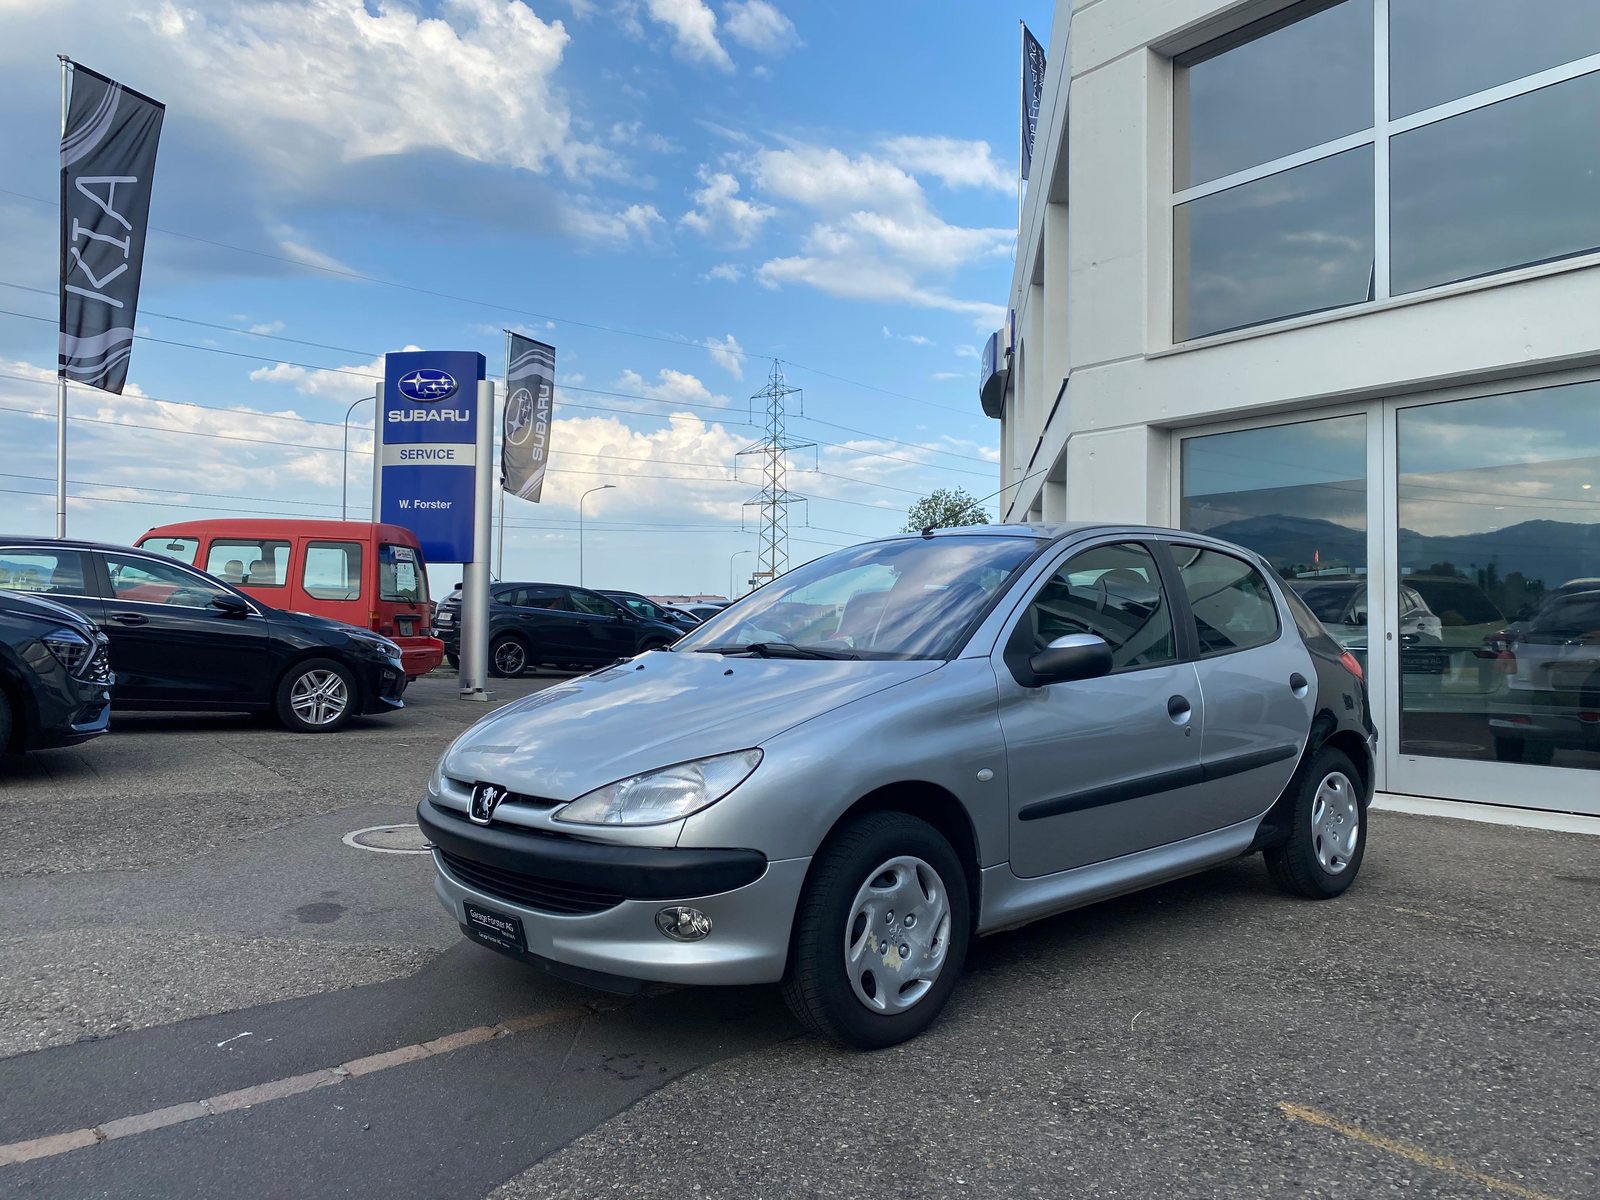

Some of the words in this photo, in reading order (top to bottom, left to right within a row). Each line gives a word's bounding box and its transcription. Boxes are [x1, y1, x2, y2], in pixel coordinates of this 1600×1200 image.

[65, 176, 137, 308] KIA
[388, 409, 470, 423] SUBARU
[532, 384, 550, 462] SUBARU
[400, 449, 455, 460] SERVICE
[399, 499, 411, 509] W.
[414, 499, 452, 509] Forster
[470, 909, 487, 923] Garage
[505, 922, 514, 932] AG
